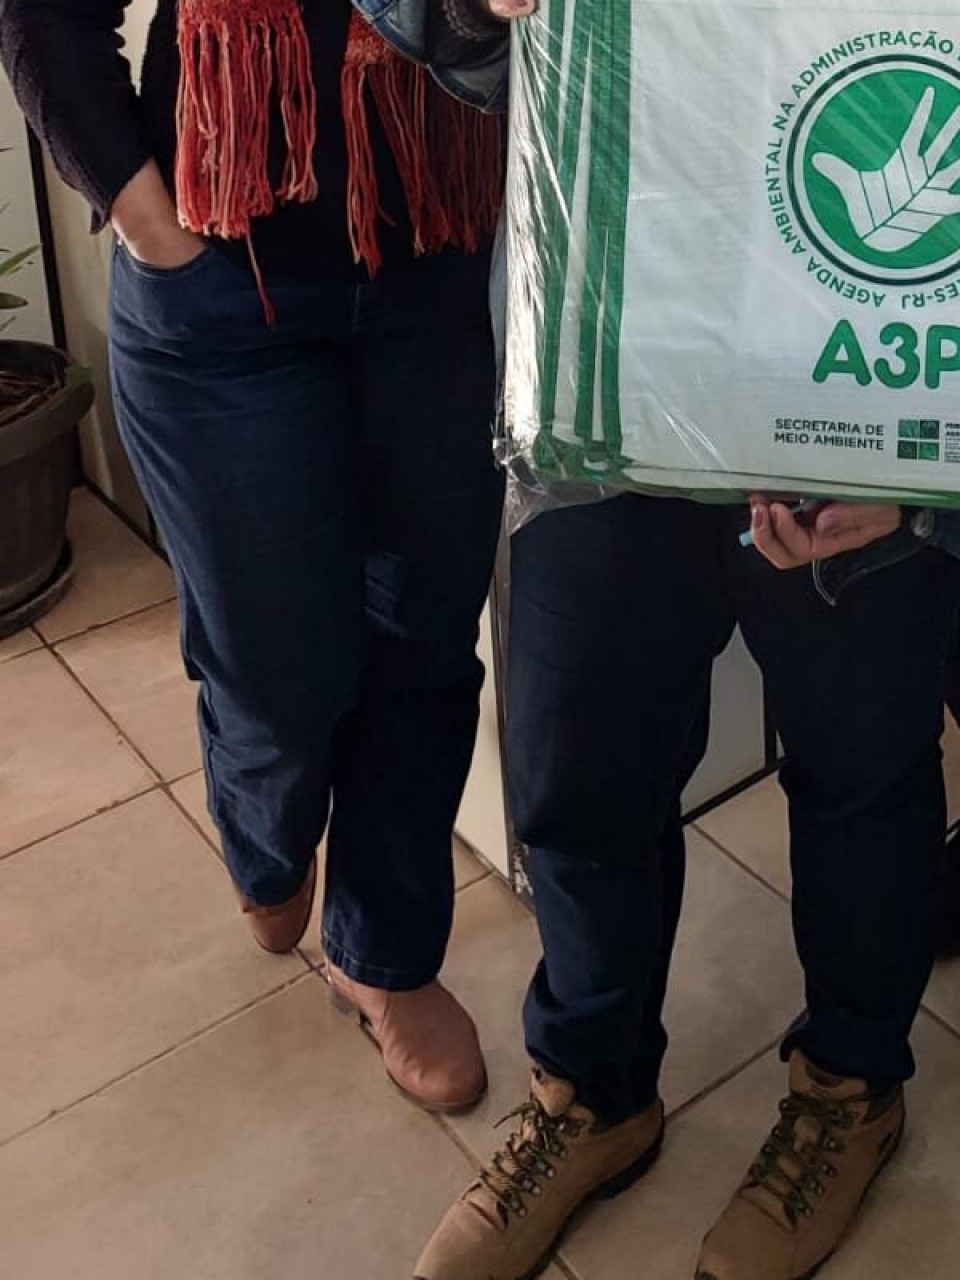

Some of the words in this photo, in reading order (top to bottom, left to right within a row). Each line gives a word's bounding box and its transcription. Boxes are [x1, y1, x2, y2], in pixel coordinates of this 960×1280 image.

[791, 30, 954, 98] ADMINISTRAÇÃO
[772, 100, 796, 131] NA
[765, 138, 806, 255] AMBIENTAL
[806, 256, 886, 308] AGENDA
[774, 432, 809, 444] MEIO
[813, 436, 884, 450] AMBIENTE
[775, 418, 863, 435] SECRETARIA
[865, 424, 884, 435] DE
